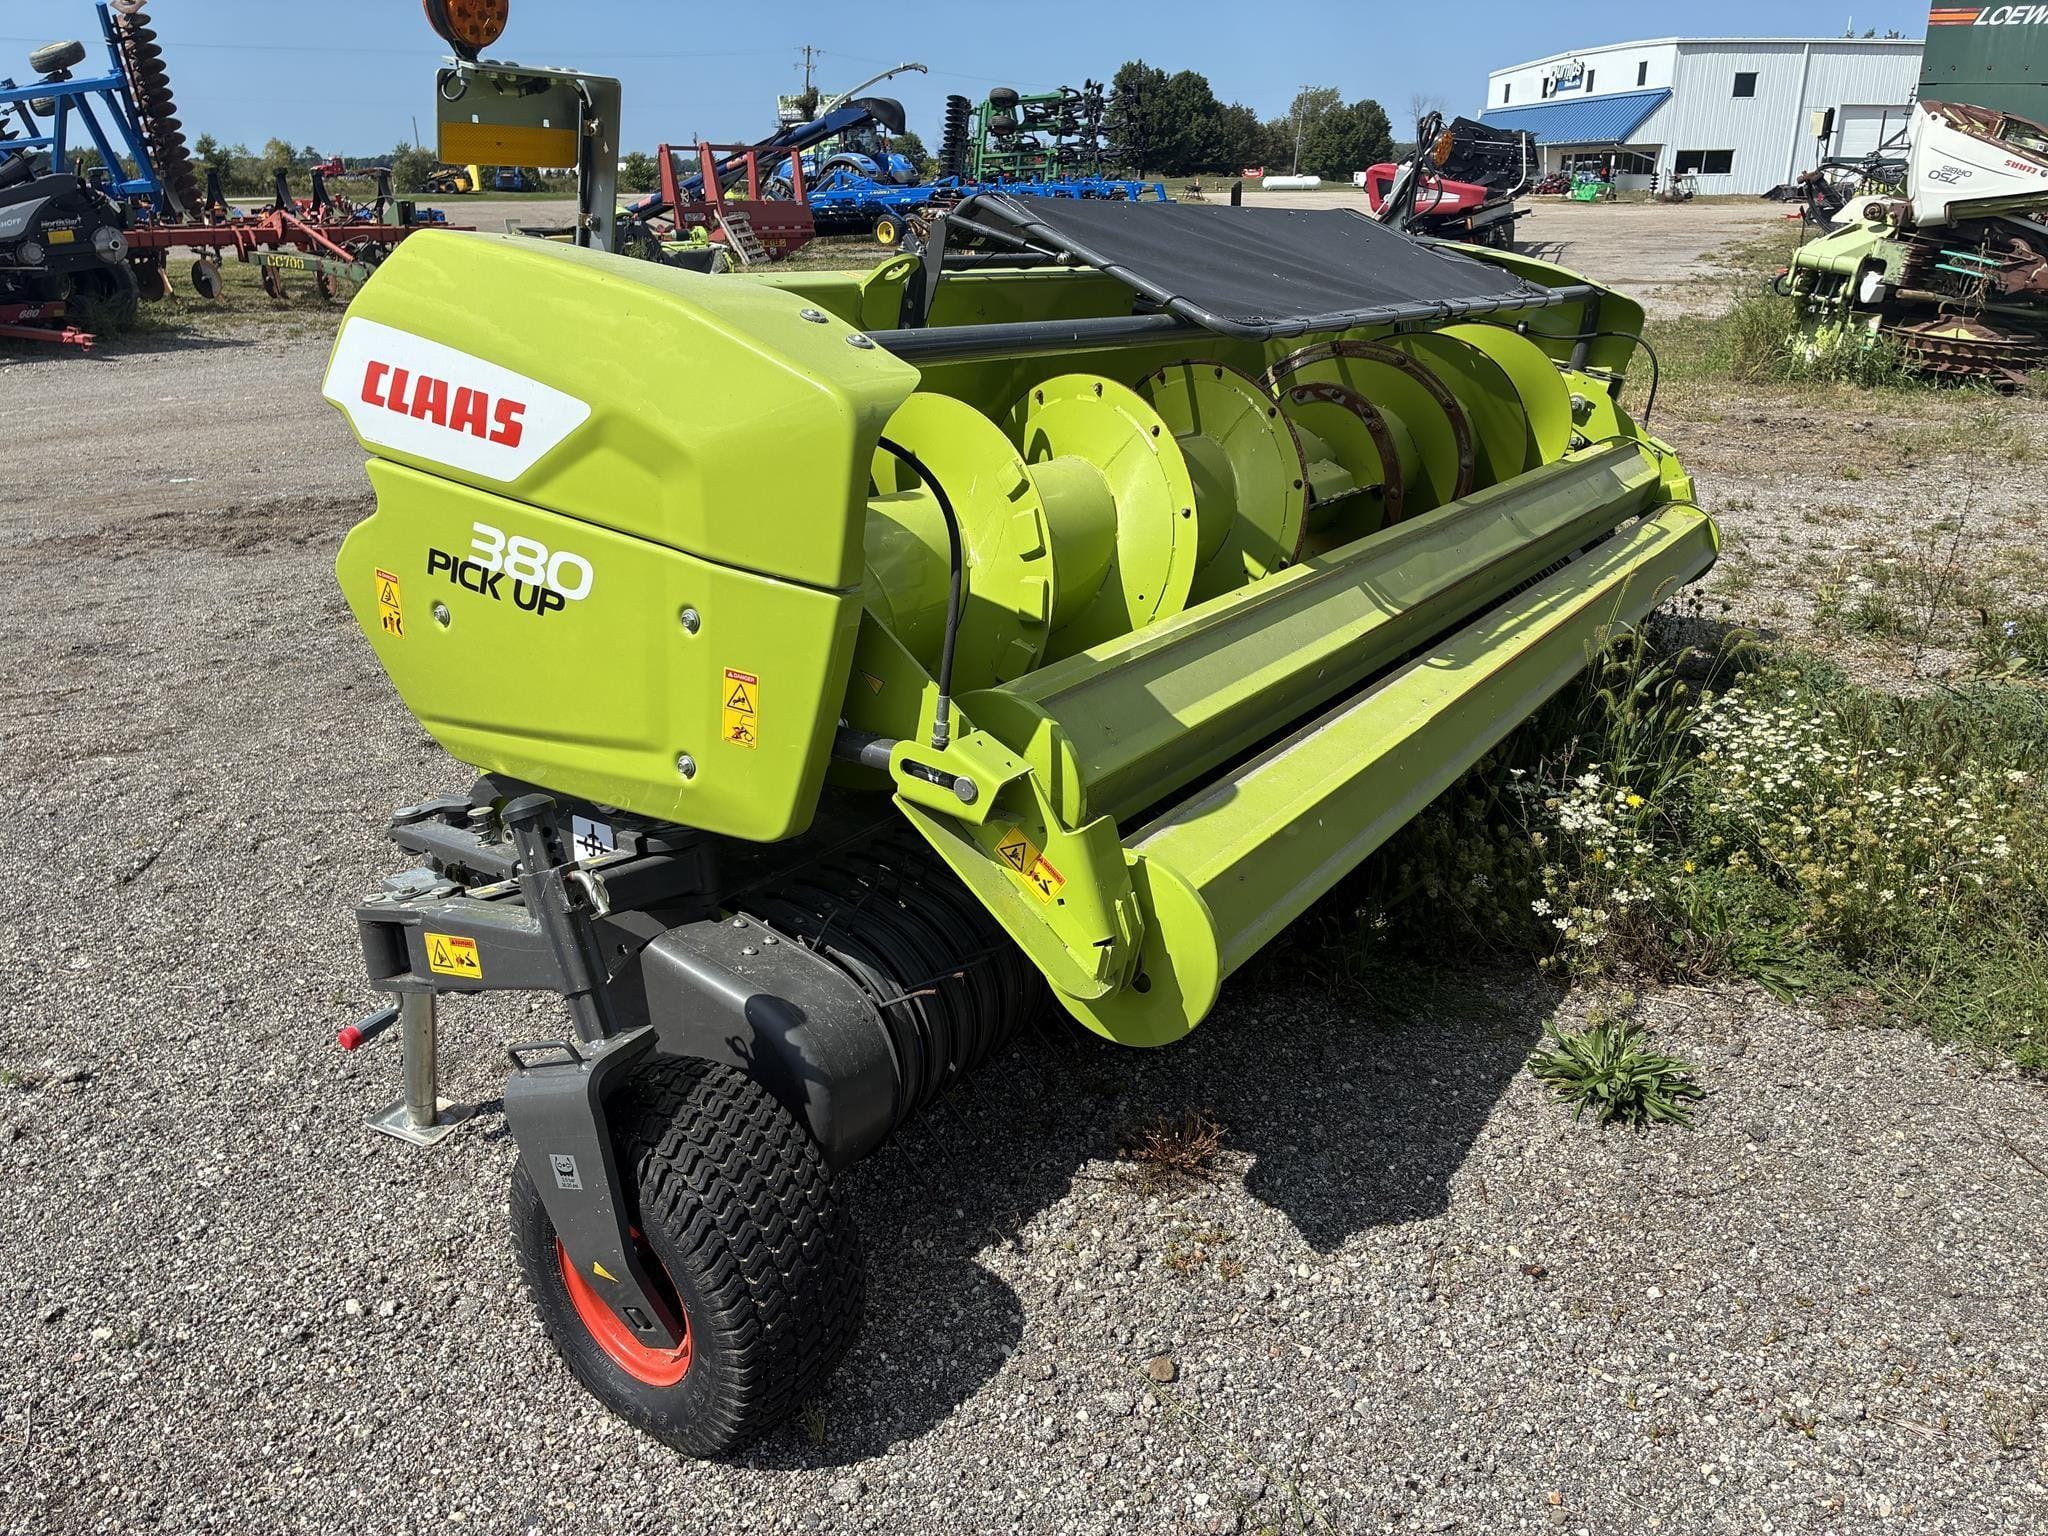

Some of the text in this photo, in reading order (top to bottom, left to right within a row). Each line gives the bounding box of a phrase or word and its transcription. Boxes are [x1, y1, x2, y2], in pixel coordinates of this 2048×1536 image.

[1941, 165, 1973, 178] ORBIS
[2004, 159, 2038, 175] CLAAS
[1928, 169, 1961, 185] 750
[361, 360, 526, 448] CLAAS
[467, 521, 594, 601] 380
[427, 548, 566, 617] PICK UP
[733, 672, 756, 684] DANGER
